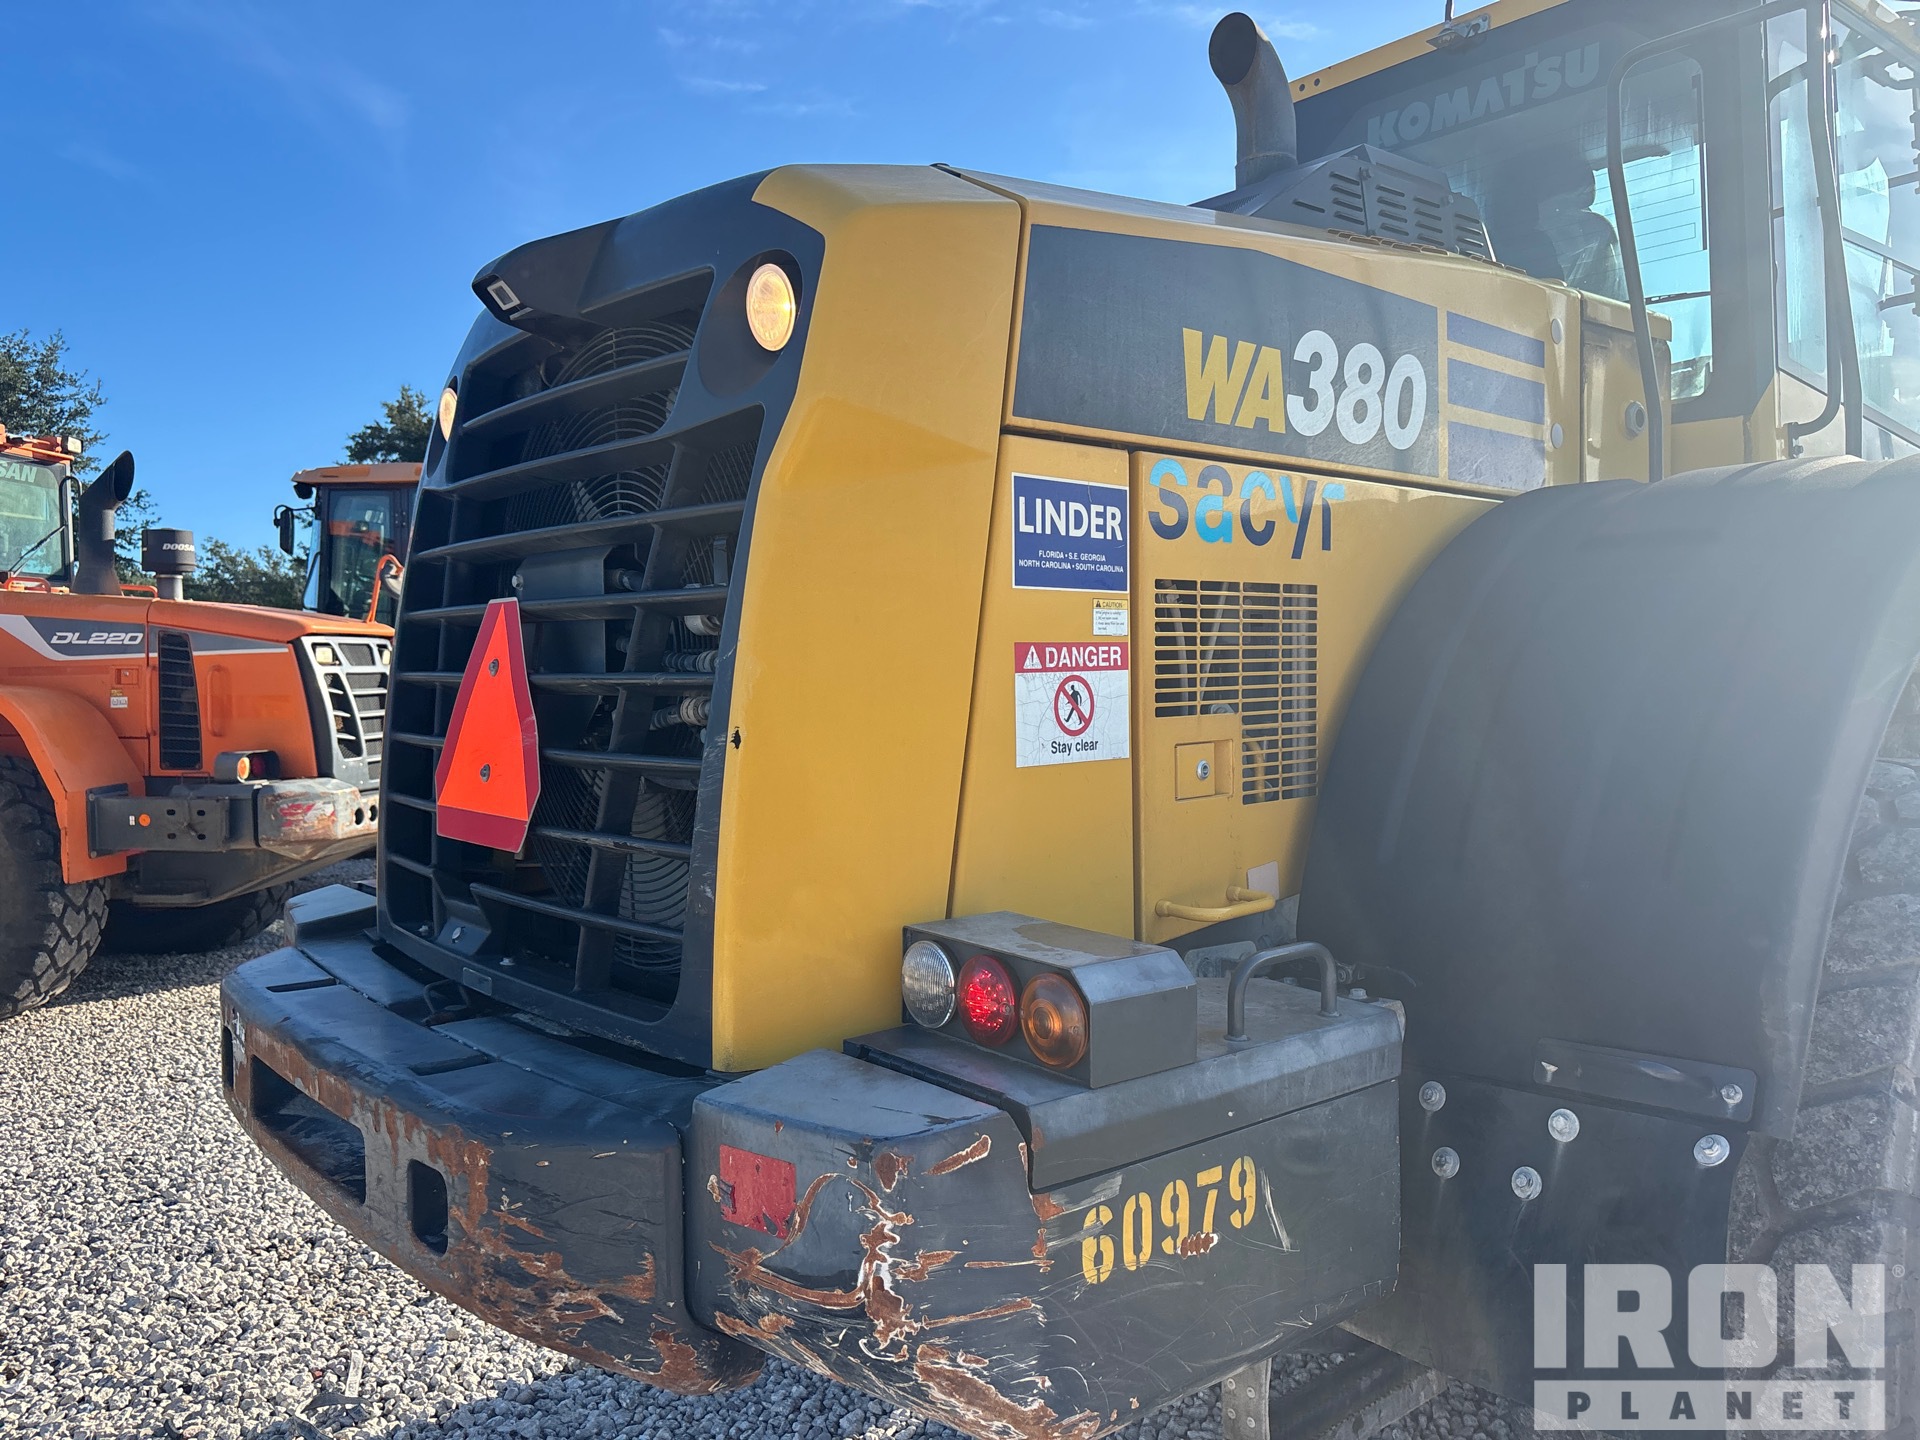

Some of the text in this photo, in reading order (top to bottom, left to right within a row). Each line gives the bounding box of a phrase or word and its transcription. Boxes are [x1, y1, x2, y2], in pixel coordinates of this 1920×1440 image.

[1365, 41, 1600, 150] KOMATSU
[1182, 327, 1427, 450] WA380
[1018, 496, 1123, 541] LINDER
[1148, 458, 1345, 560] sacyr
[1018, 559, 1124, 573] NORTH CAROLINA SOUTH CAROLINA
[1038, 549, 1106, 562] FLORIDA S.E. GEORGIA
[50, 632, 144, 645] DL220
[1045, 645, 1122, 668] DANGER
[1050, 738, 1099, 756] Stay clear
[1081, 1155, 1257, 1285] 60979
